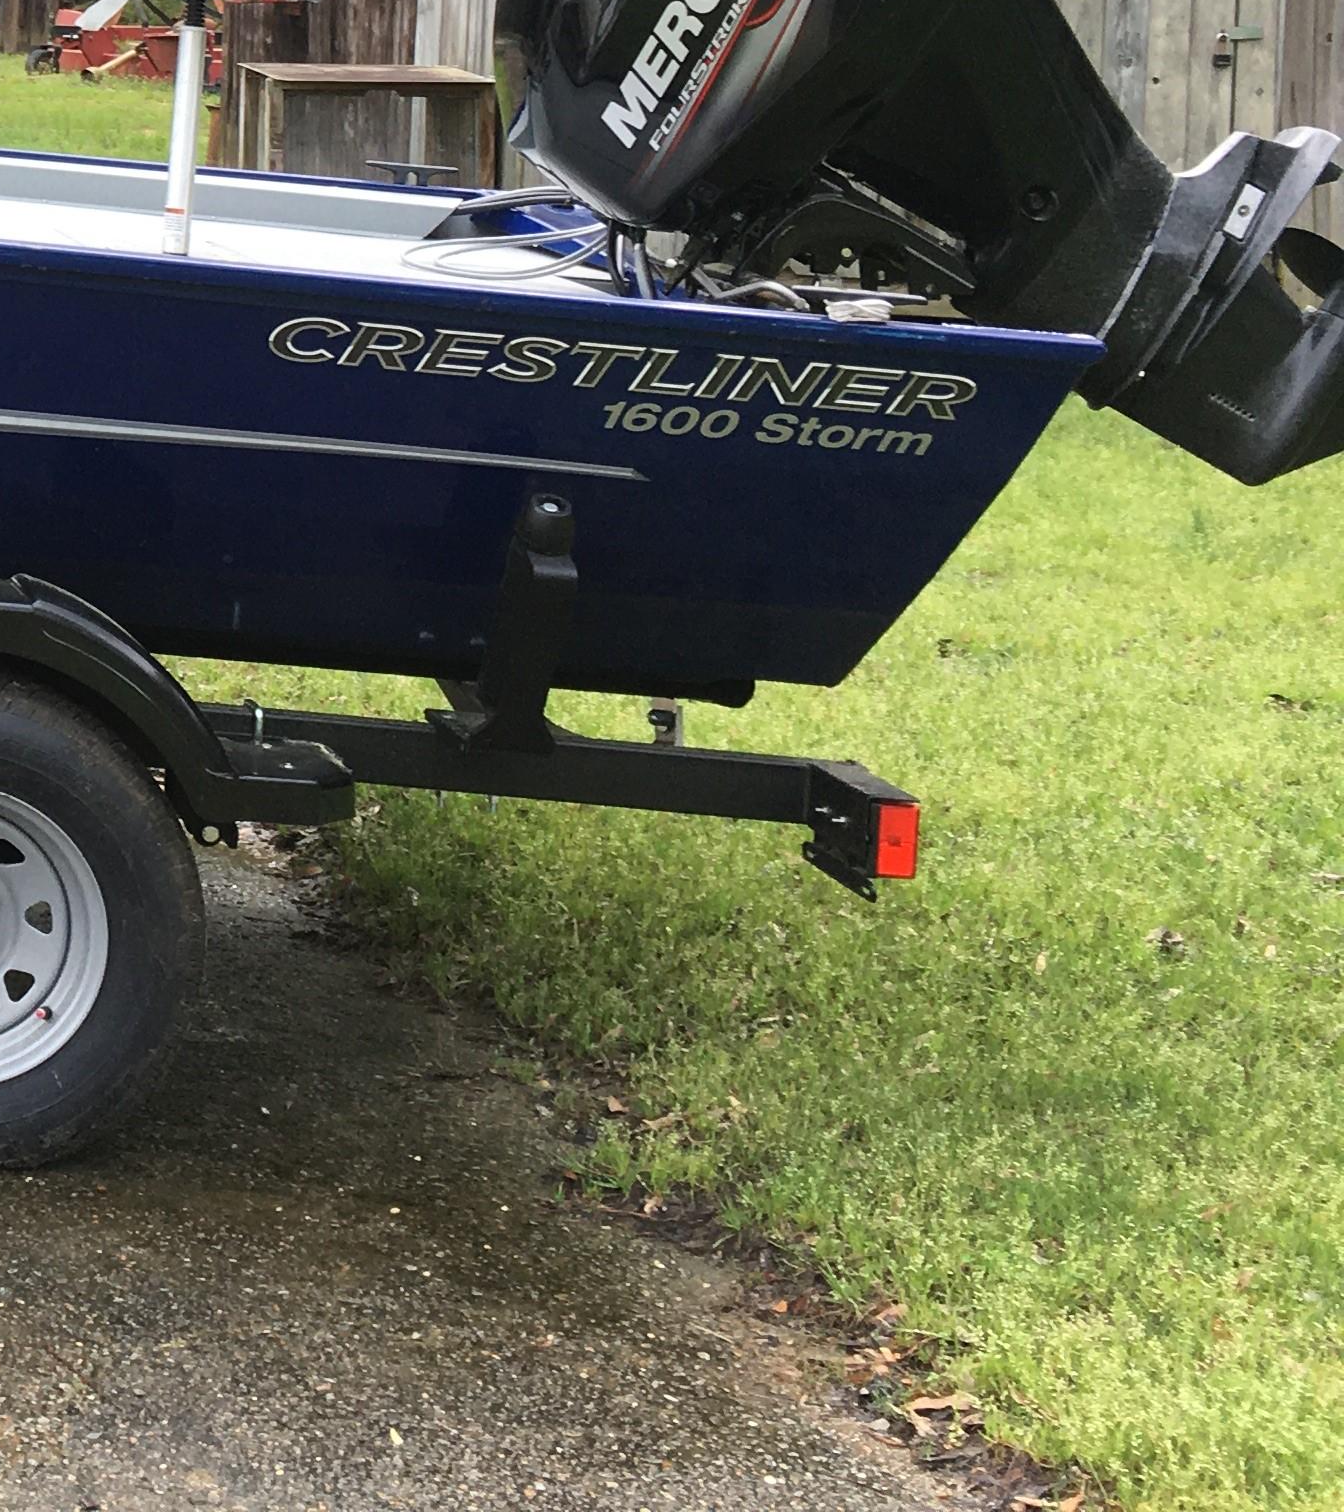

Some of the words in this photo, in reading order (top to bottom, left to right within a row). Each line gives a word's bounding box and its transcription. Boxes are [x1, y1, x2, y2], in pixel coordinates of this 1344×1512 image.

[267, 316, 978, 423] CRESTLINER
[602, 400, 740, 440] 1600
[754, 412, 935, 456] Storm
